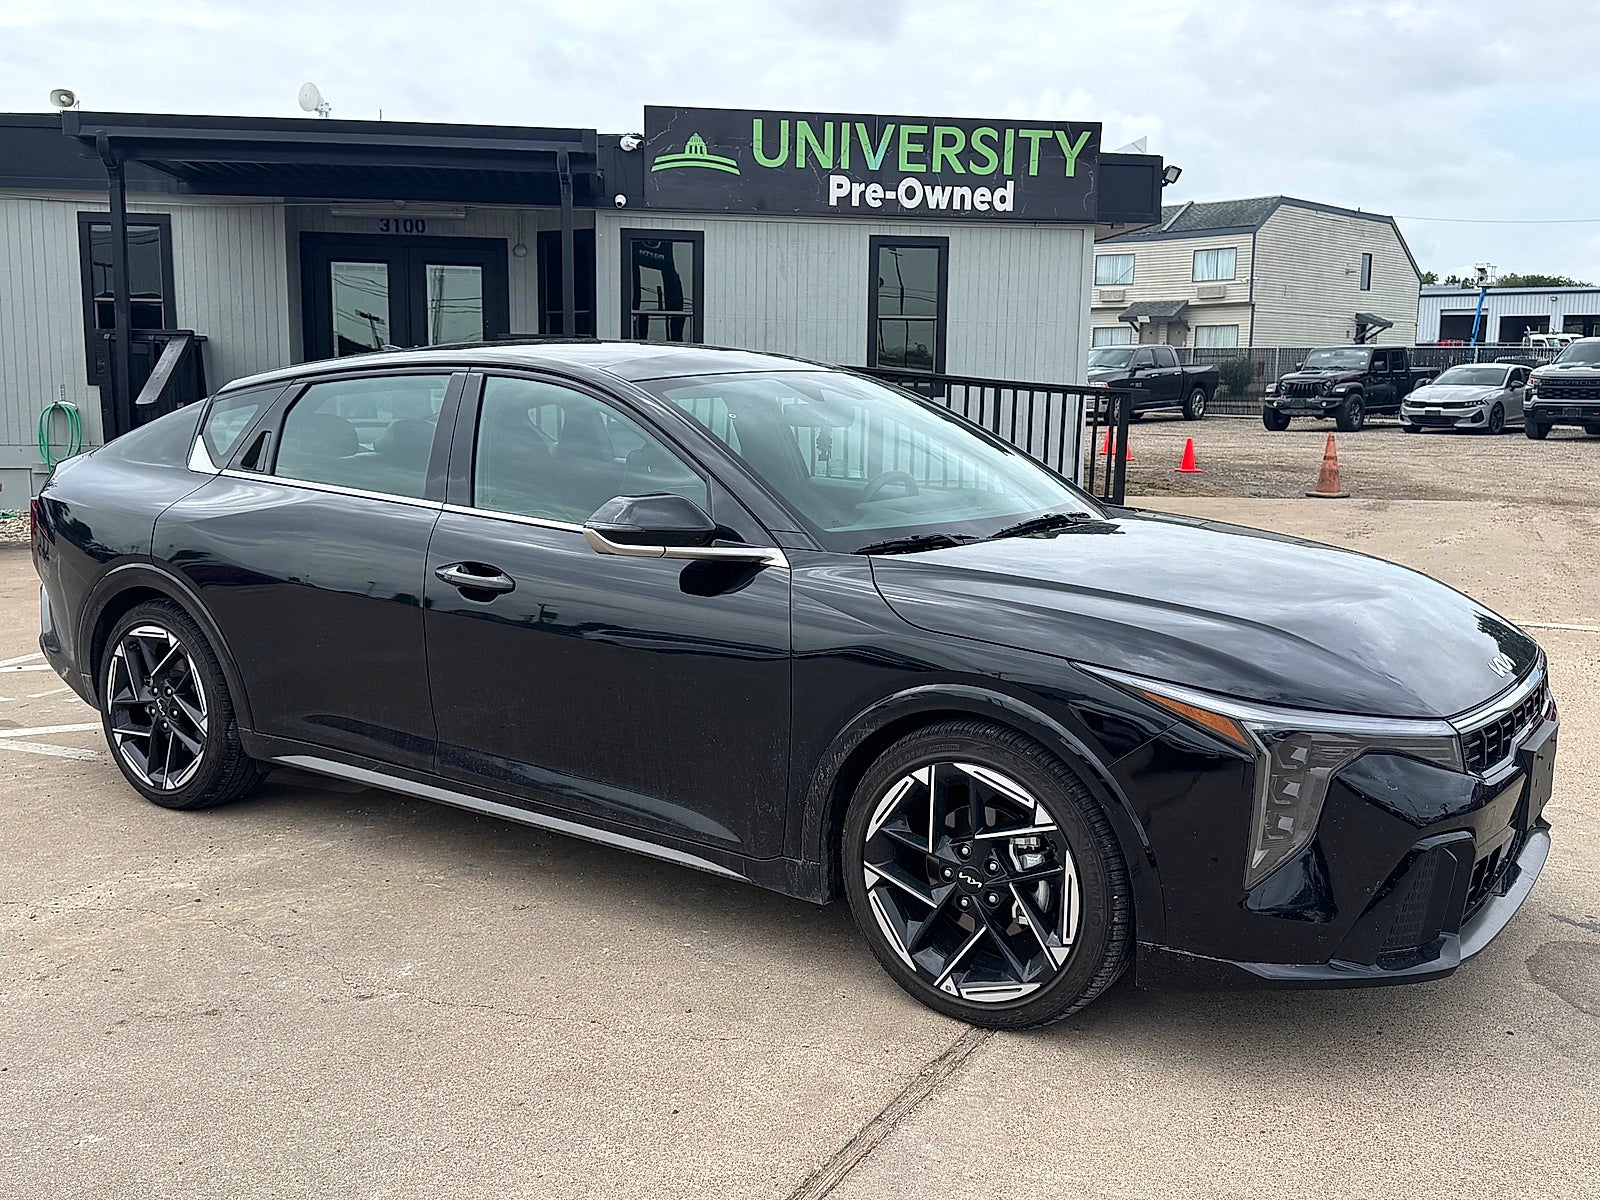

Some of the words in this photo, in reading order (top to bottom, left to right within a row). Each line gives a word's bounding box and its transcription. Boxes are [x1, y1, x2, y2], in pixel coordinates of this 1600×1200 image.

[752, 118, 1091, 176] UNIVERSITY
[829, 174, 1014, 212] Pre-Owned
[379, 218, 426, 233] 3100
